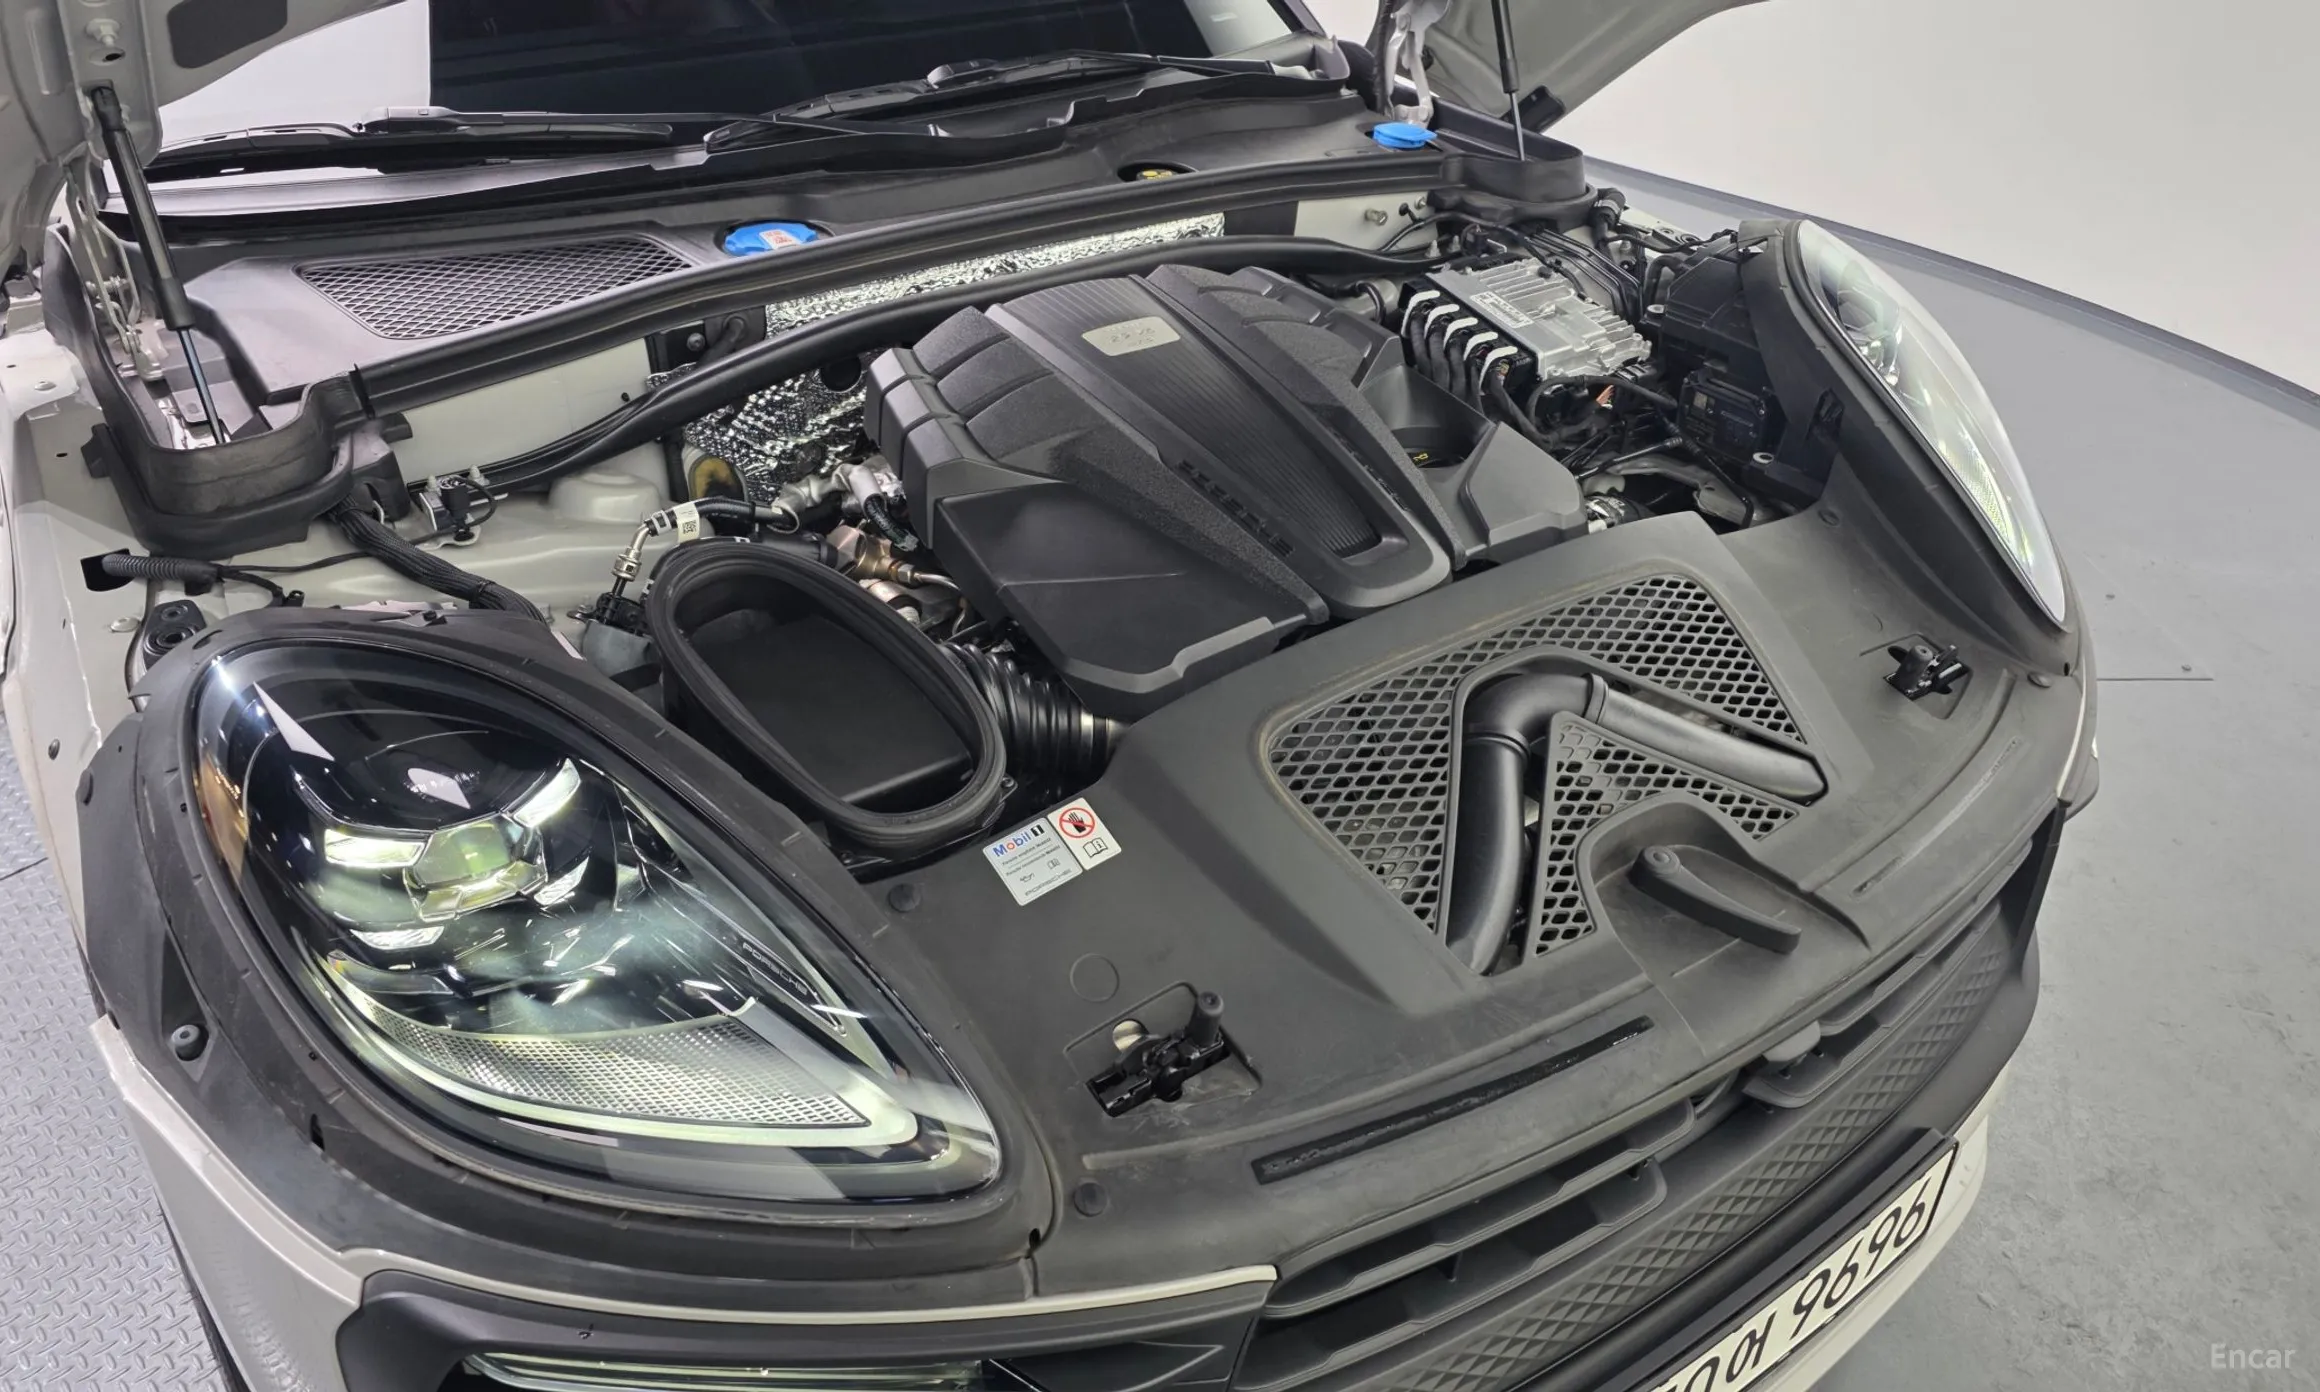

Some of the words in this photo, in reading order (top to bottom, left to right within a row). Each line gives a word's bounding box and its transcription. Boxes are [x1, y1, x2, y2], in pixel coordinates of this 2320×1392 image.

[992, 831, 1031, 857] Mobil
[742, 942, 808, 995] PORSCHE
[1790, 1176, 1931, 1341] 9696
